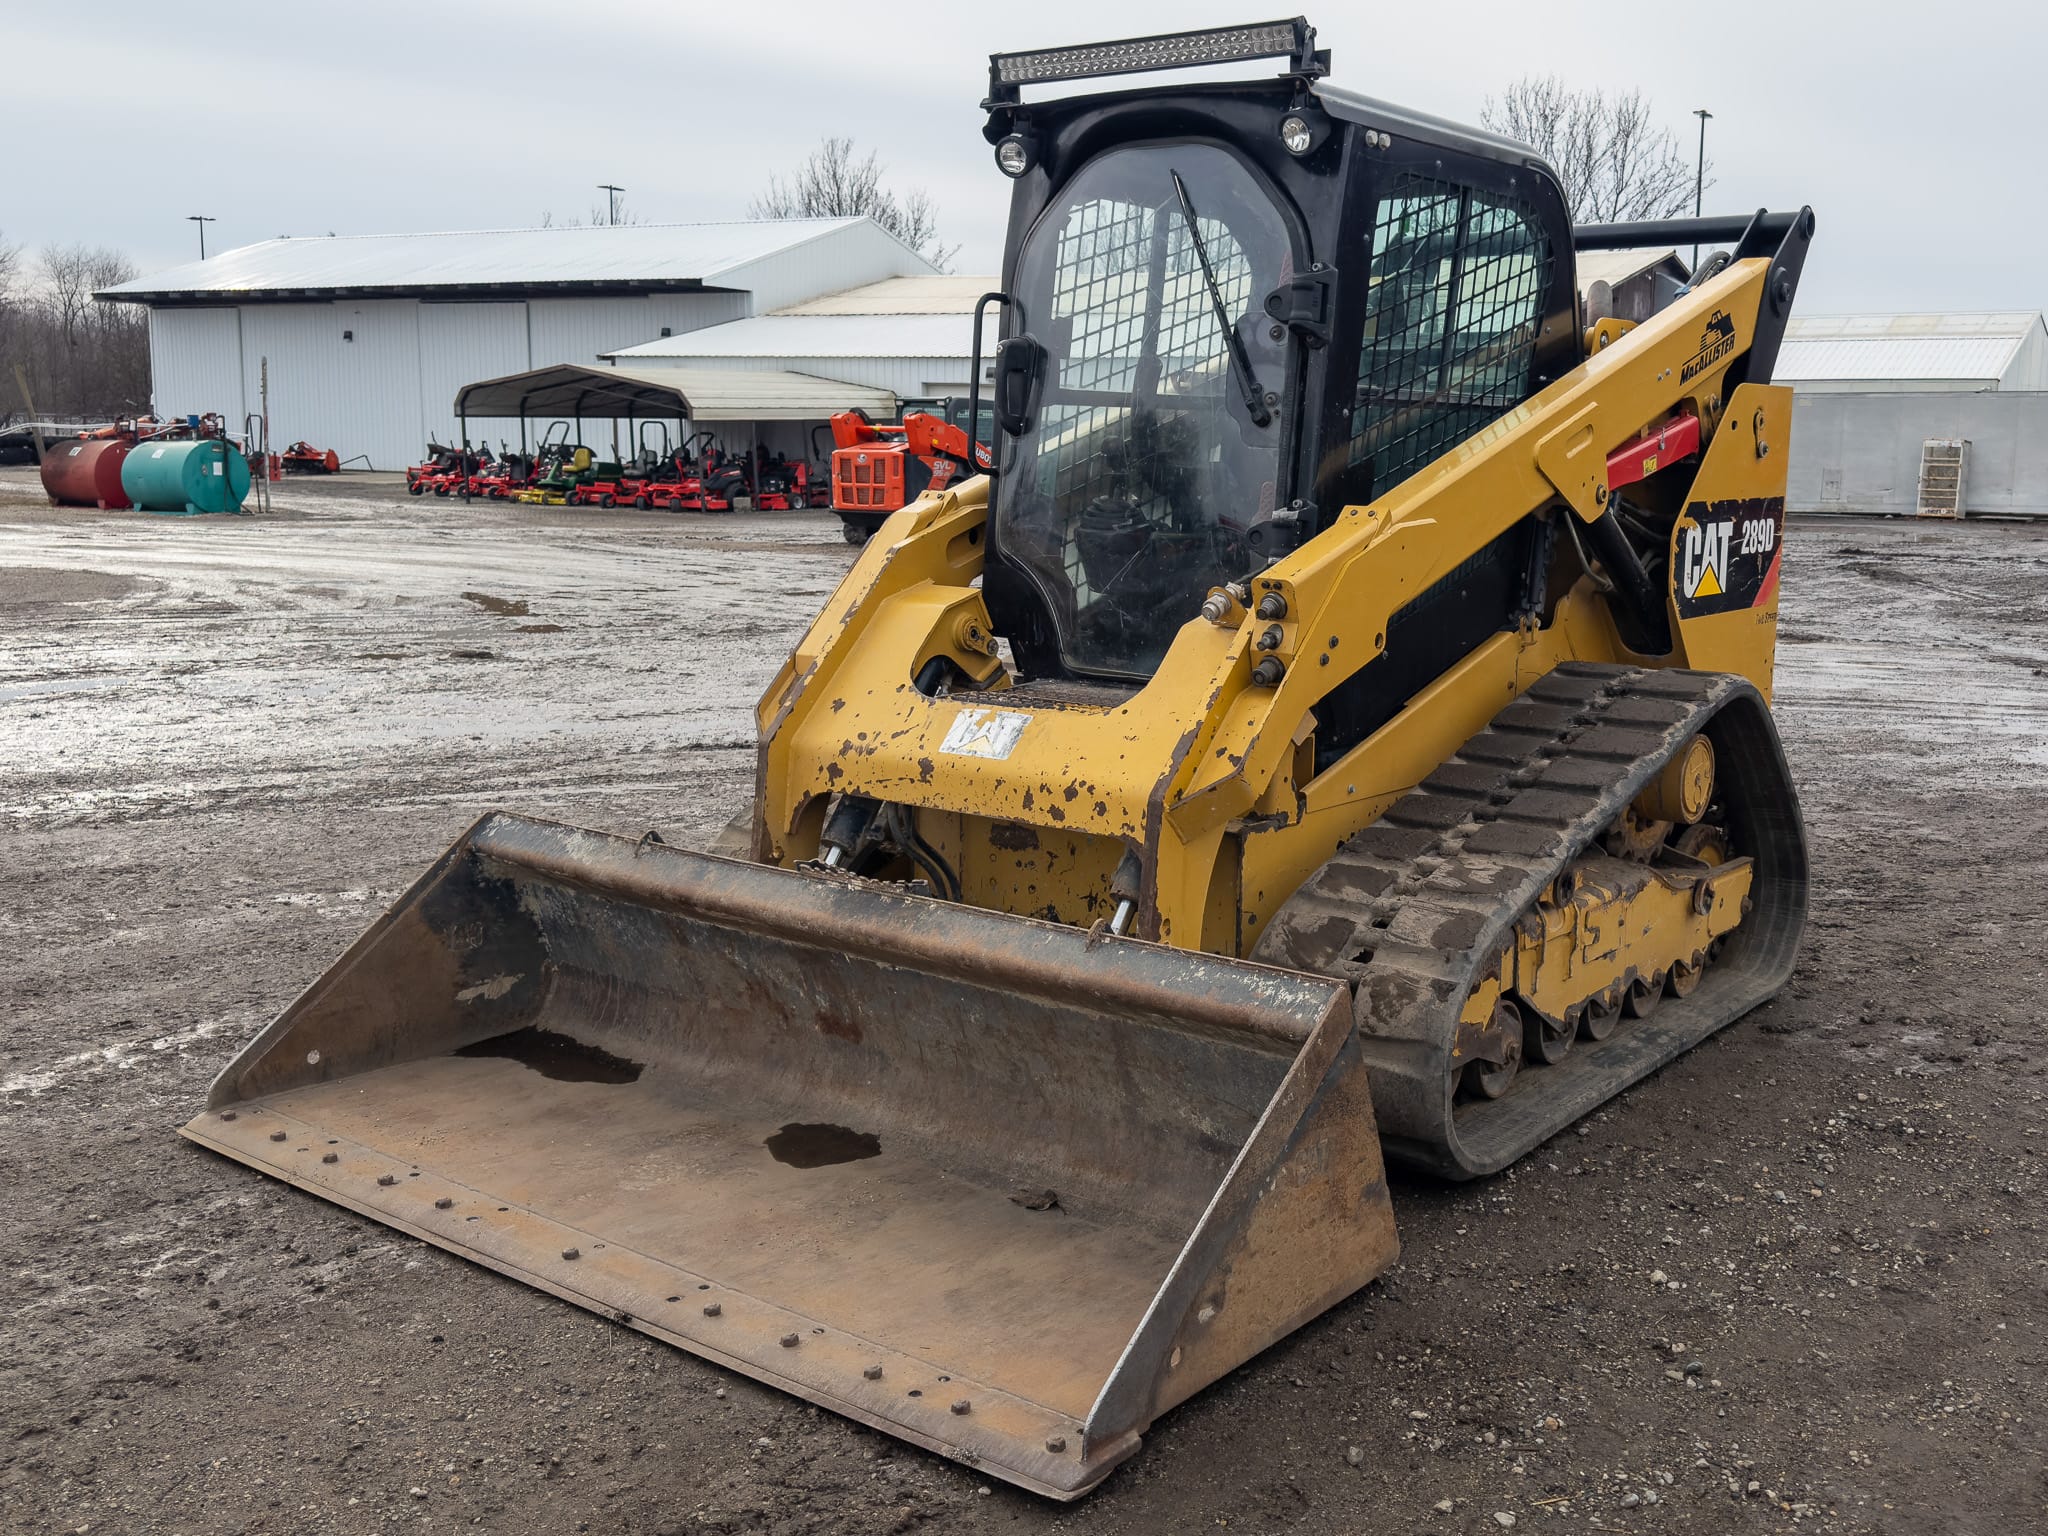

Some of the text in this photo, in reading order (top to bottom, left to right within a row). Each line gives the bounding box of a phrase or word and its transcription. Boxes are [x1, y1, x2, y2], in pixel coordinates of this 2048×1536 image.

[1683, 518, 1775, 599] CAT 289D
[945, 710, 1027, 758] CAT
